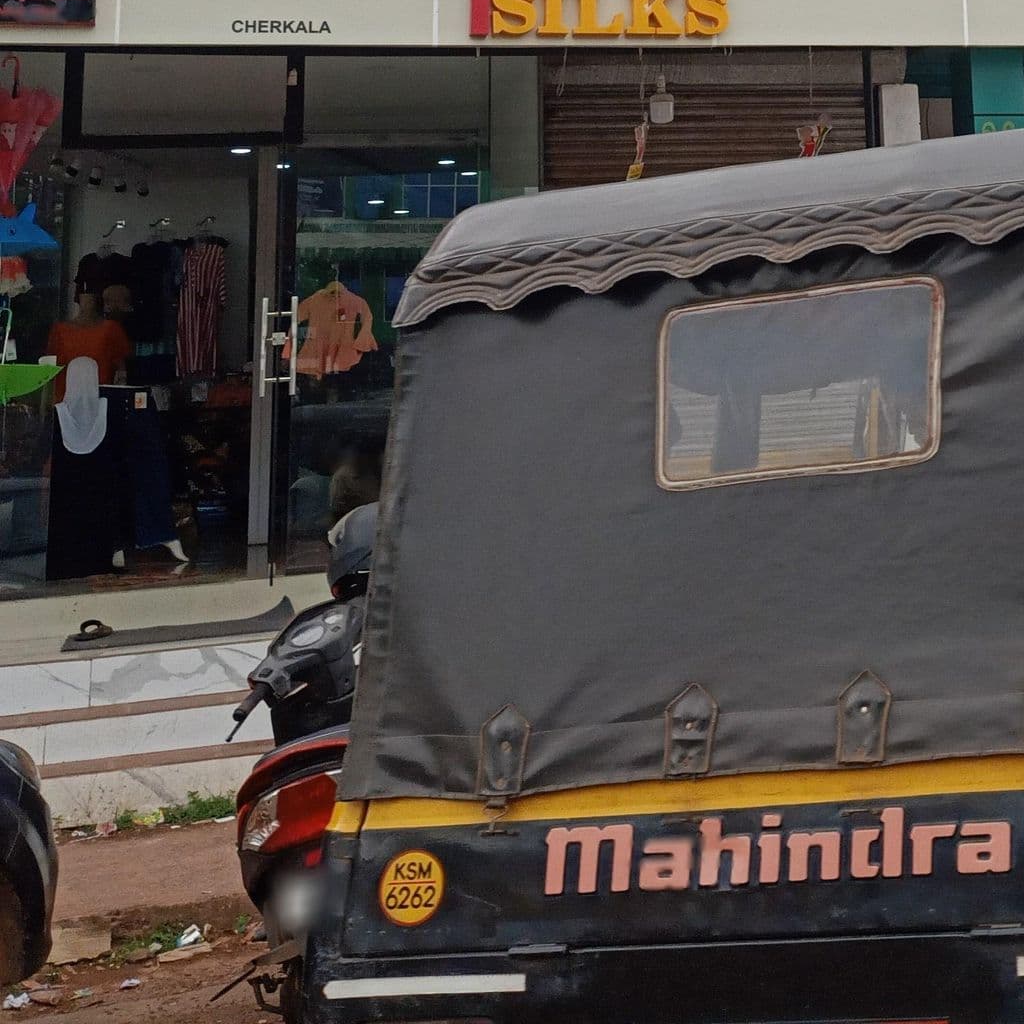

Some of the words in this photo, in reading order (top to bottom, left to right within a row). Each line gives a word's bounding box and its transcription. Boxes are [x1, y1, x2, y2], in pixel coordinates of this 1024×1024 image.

[231, 20, 331, 34] CHERKALA
[394, 861, 433, 881] KSM
[385, 885, 436, 911] 6262
